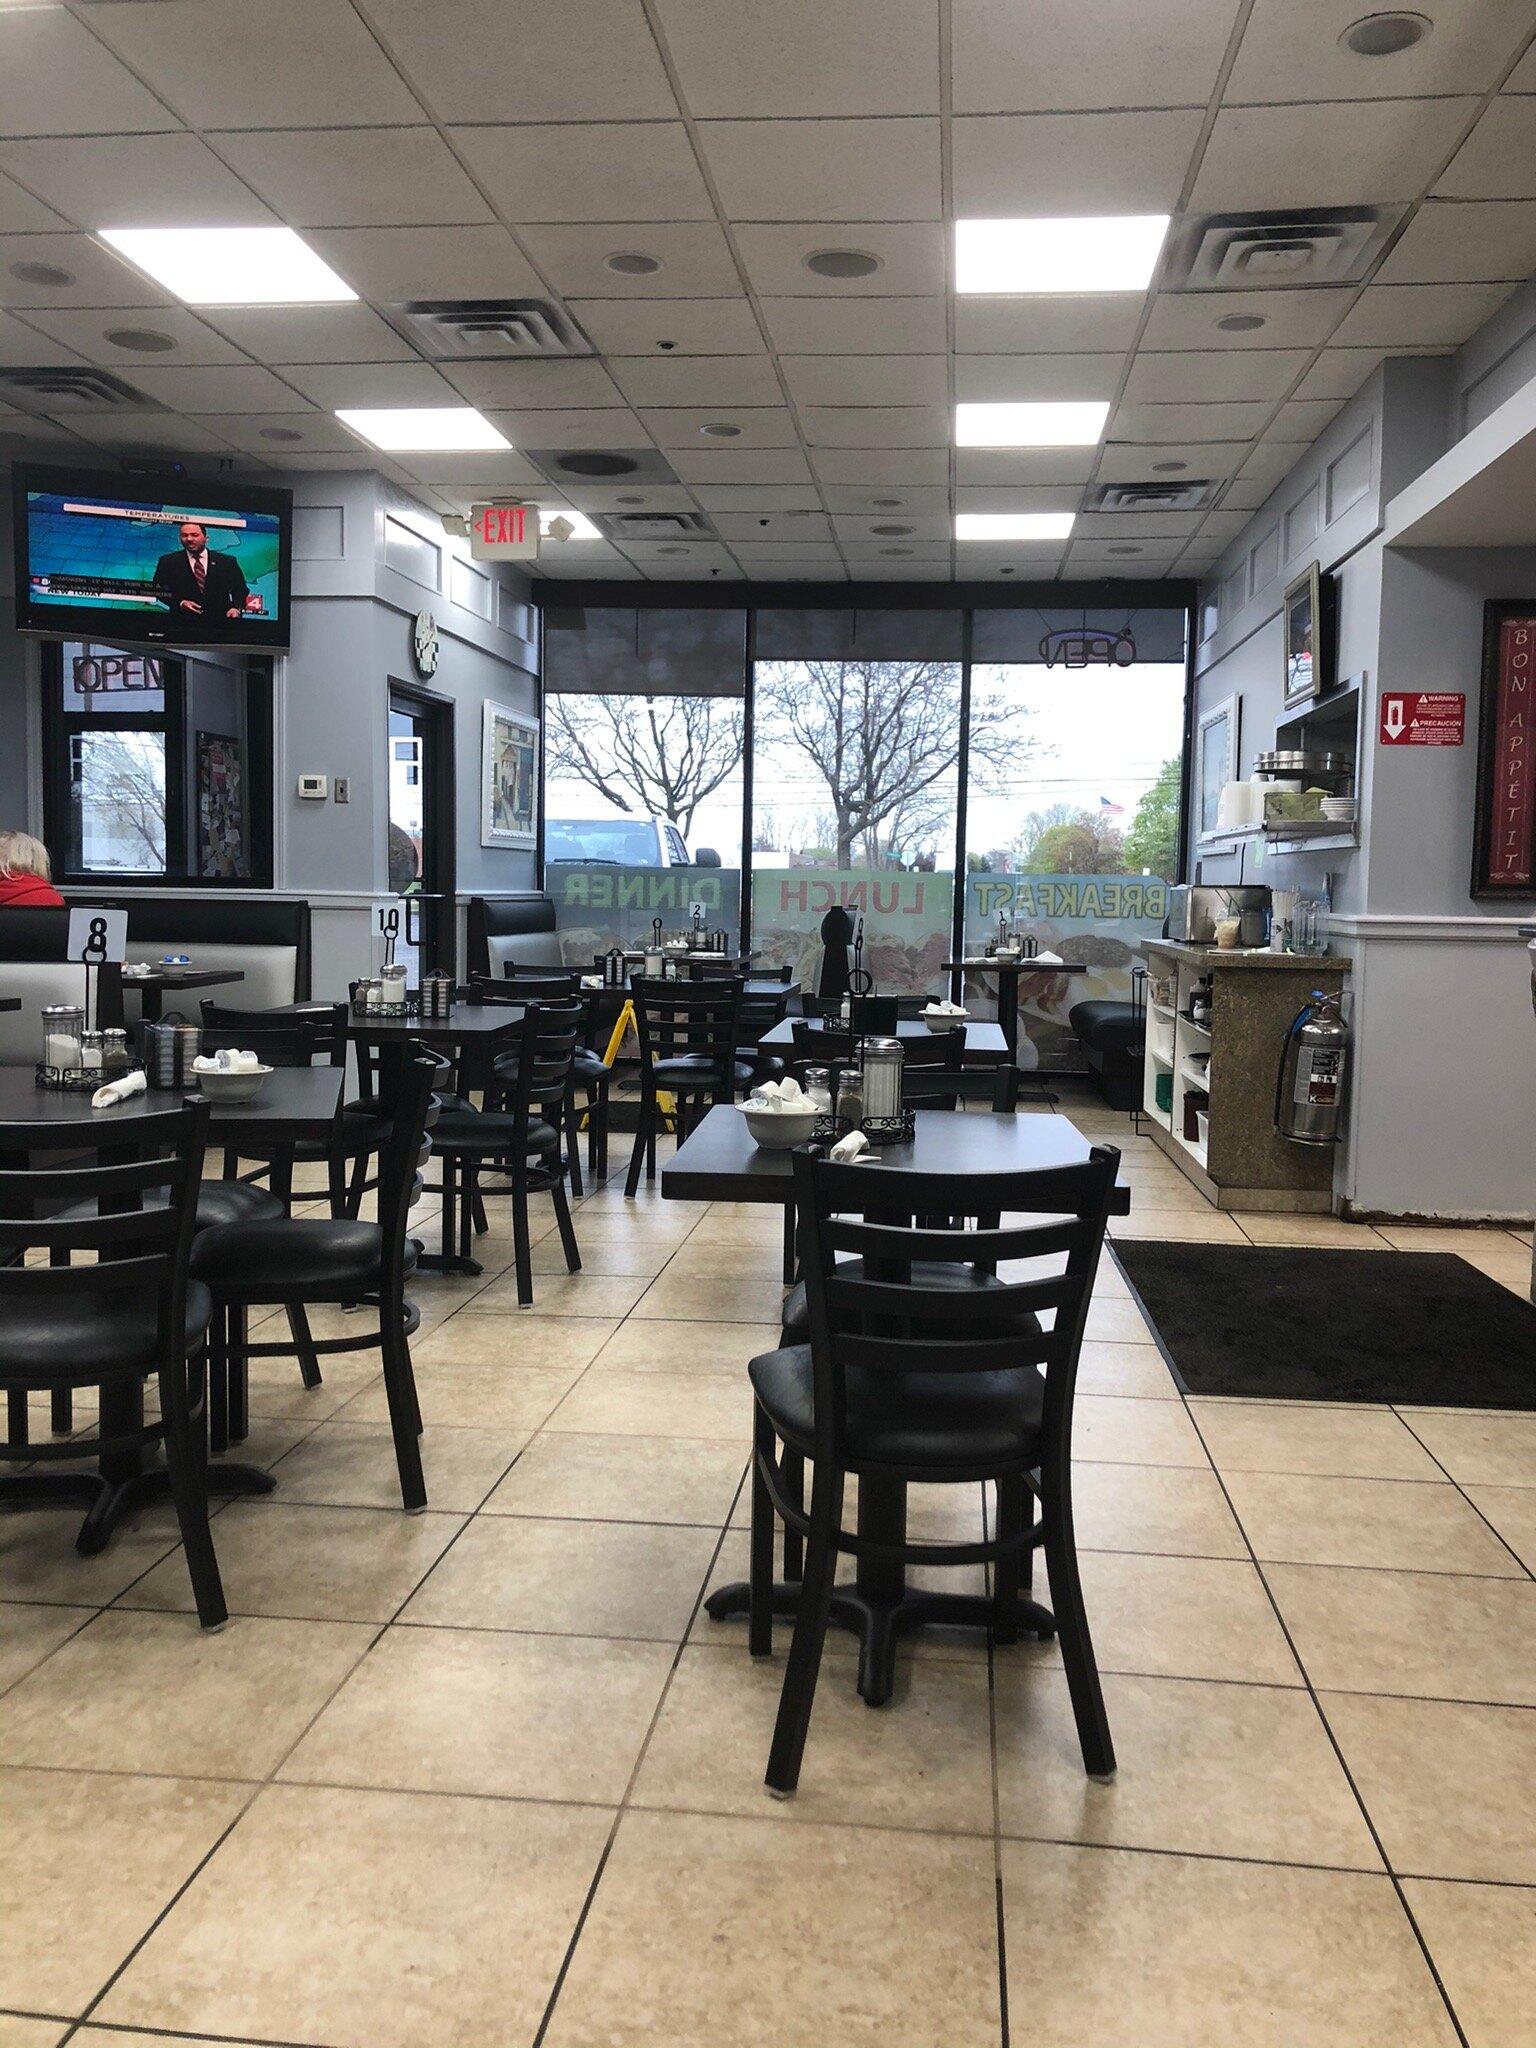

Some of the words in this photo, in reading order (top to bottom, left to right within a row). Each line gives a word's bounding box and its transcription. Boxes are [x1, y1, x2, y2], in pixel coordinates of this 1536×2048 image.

[124, 510, 190, 521] TEMPERATURES
[483, 509, 526, 543] EXIT
[247, 597, 262, 610] 4
[1511, 628, 1528, 693] BON
[377, 908, 400, 931] 10
[694, 904, 701, 915] 2
[88, 917, 107, 952] 8
